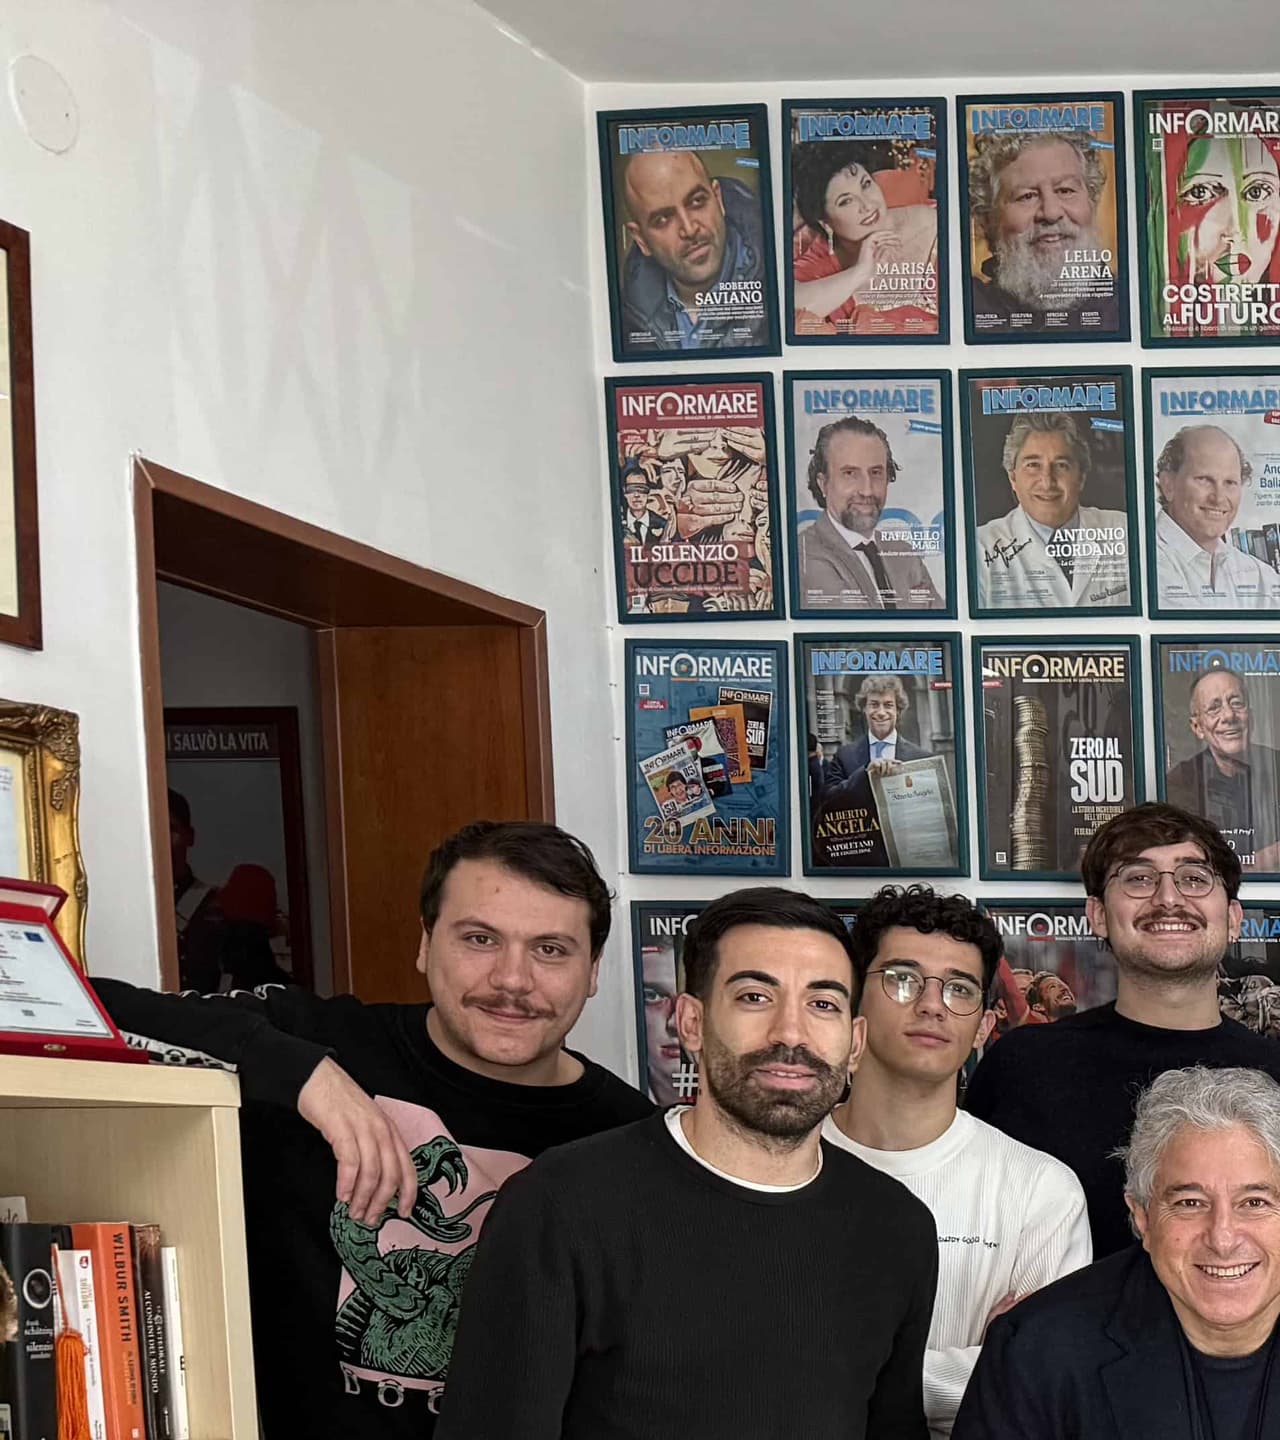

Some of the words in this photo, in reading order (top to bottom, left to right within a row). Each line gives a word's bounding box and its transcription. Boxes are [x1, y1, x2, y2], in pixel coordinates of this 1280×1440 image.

[800, 113, 930, 141] INFORMARE
[972, 106, 1104, 134] INFORMARE
[619, 122, 750, 154] INFORMARE
[1065, 249, 1112, 263] LELLO
[876, 262, 936, 274] MARISA
[1060, 265, 1112, 278] ARENA
[720, 281, 761, 290] ROBERTO
[870, 278, 936, 290] LAURITO
[695, 291, 762, 305] SAVIANO
[1163, 314, 1180, 324] AL
[622, 392, 758, 416] INFORMARE
[804, 388, 935, 416] INFORMARE
[982, 385, 1116, 415] INFORMARE
[912, 541, 940, 550] MAGI
[1053, 528, 1125, 542] ANTONIO
[630, 546, 648, 562] IL
[652, 544, 739, 562] SILENZIO
[1045, 543, 1125, 557] GIORDANO
[632, 562, 739, 588] UCCIDE
[636, 653, 772, 676] INFORMARE
[812, 650, 943, 675] INFORMARE
[988, 655, 1124, 677] INFORMARE
[722, 689, 769, 702] INFORMARE
[173, 728, 217, 752] SALVÒ
[219, 733, 237, 751] LA
[239, 731, 269, 751] VITA
[746, 729, 765, 745] SUD
[1070, 737, 1104, 759] ZERO
[1106, 738, 1122, 758] AL
[1070, 760, 1124, 802] SUD
[824, 808, 868, 822] ALBERTO
[644, 816, 683, 845] 20
[689, 816, 775, 846] ANNI
[816, 817, 880, 838] ANGELA
[644, 844, 656, 853] DI
[658, 844, 692, 854] LIBERA
[694, 845, 776, 855] INFORMAZIONE
[113, 1233, 127, 1290] WILBUR
[118, 1296, 131, 1342] SMITH
[145, 1300, 154, 1337] CONFINI
[148, 1338, 156, 1356] DEL
[151, 1358, 159, 1393] MONDO
